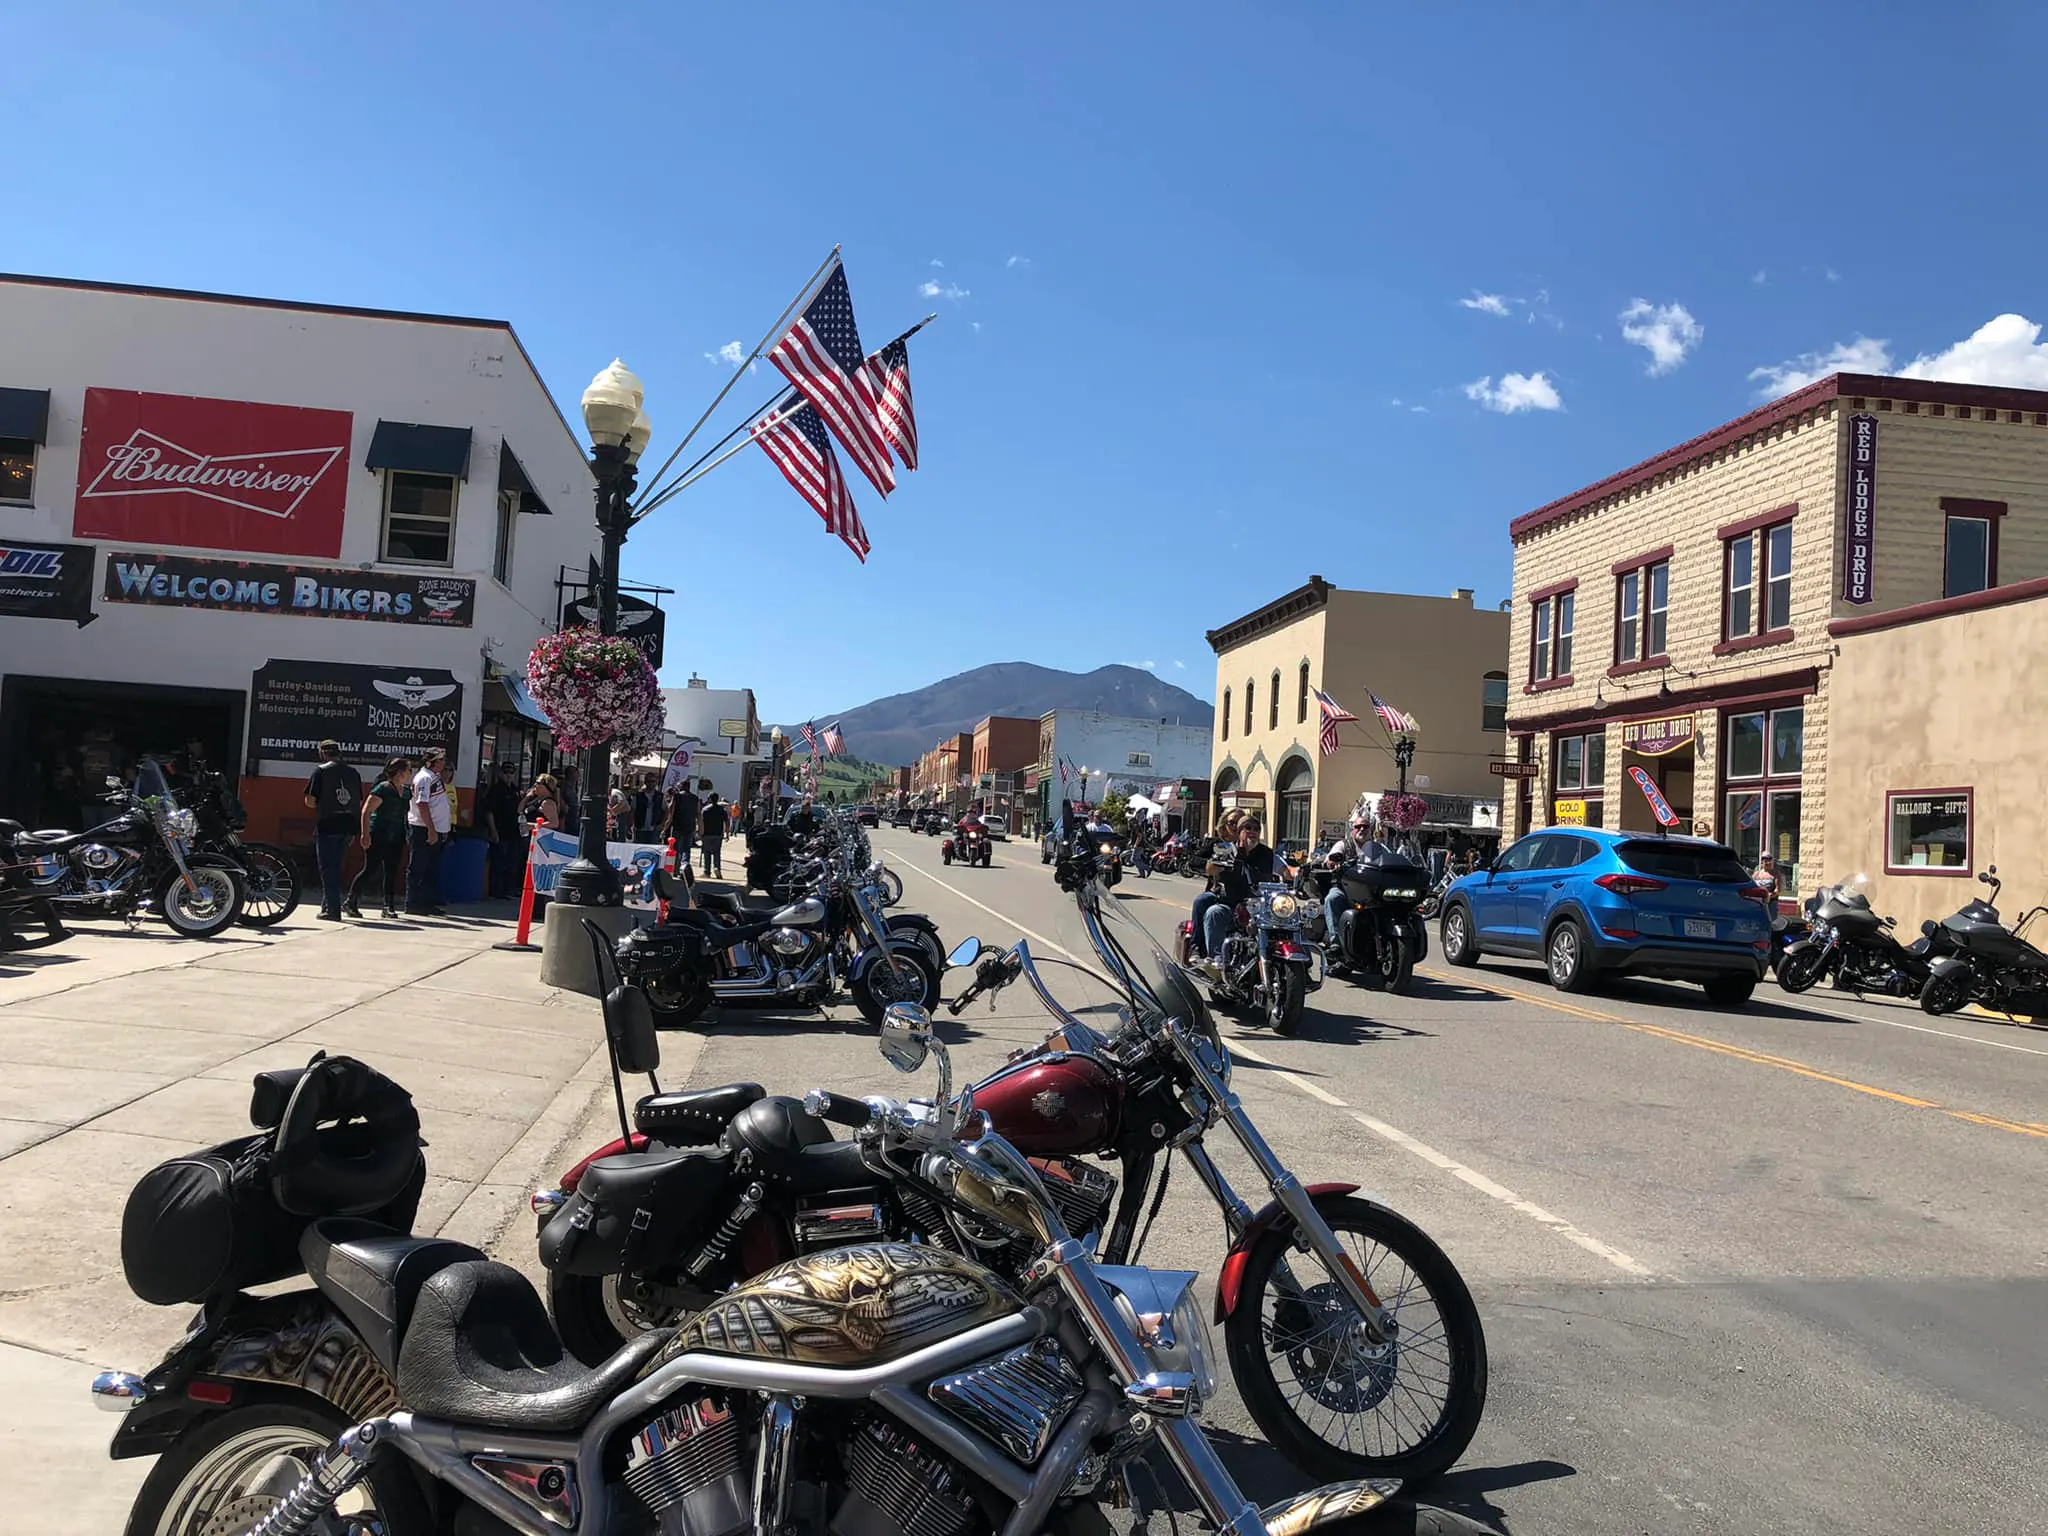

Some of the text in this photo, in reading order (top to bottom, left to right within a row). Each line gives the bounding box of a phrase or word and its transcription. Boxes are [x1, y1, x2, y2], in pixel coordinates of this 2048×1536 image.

[106, 444, 315, 493] Budweiser
[1852, 421, 1871, 598] RED LODGE DRUG
[0, 588, 55, 598] nthetics
[115, 562, 413, 616] WELCOME BIKERS
[268, 680, 352, 693] Harley-Davidson
[337, 696, 364, 706] Parts
[259, 703, 358, 718] Motorcycle Apparel
[367, 704, 457, 731] BONE DADDY'S
[376, 729, 415, 739] custom
[1624, 718, 1690, 742] RED LODGE DRUG
[363, 743, 425, 756] HEADQUART
[1559, 802, 1580, 813] COLD
[1896, 801, 1967, 815] BALLOONS GIFTS
[1555, 815, 1583, 825] DRINKS
